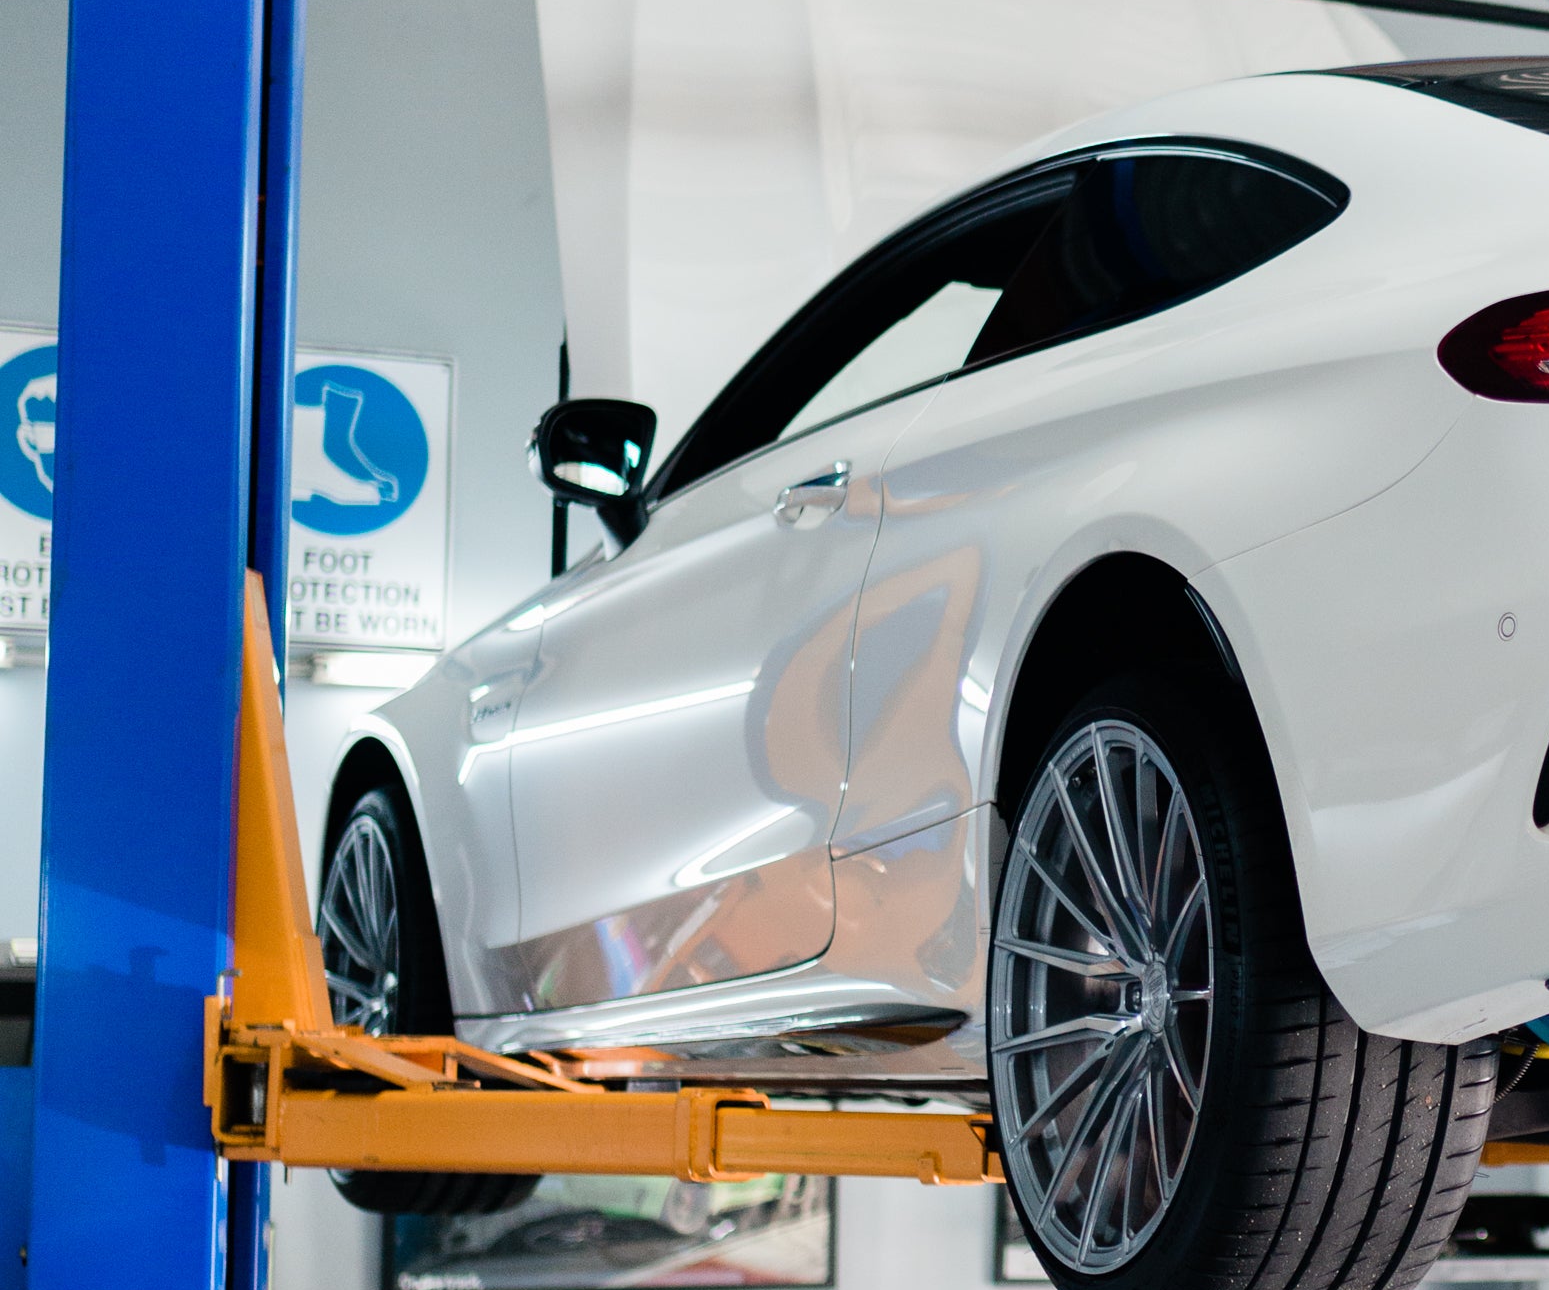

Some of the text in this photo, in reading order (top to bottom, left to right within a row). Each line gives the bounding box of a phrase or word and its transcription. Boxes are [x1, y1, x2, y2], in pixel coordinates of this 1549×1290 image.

[303, 549, 372, 574] FOOT
[290, 577, 421, 607] OTECTION
[315, 609, 348, 633] BE
[358, 611, 438, 638] WORN
[1199, 781, 1239, 949] MICHELIN
